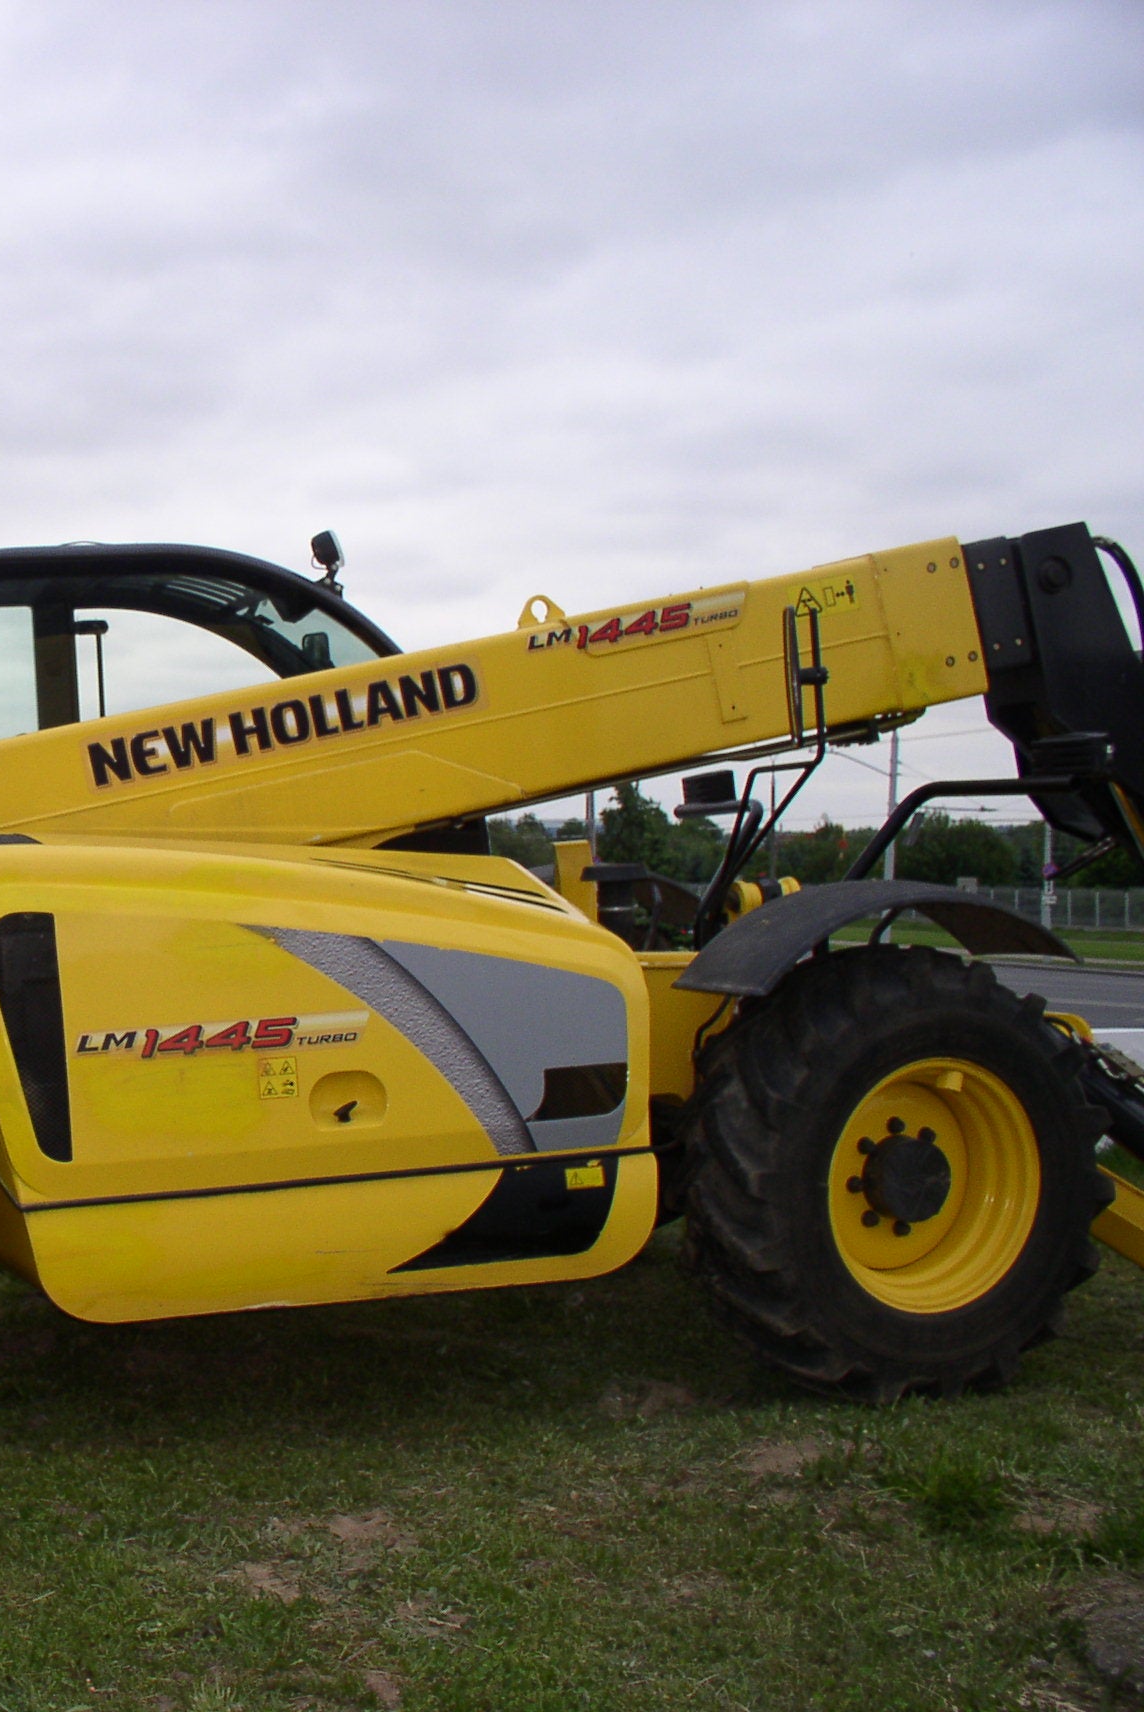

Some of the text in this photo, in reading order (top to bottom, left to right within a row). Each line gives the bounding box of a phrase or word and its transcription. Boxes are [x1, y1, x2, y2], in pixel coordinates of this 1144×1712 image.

[693, 609, 739, 625] TURBO
[87, 663, 478, 787] NEW HOLLAND
[296, 1031, 358, 1045] TURBO
